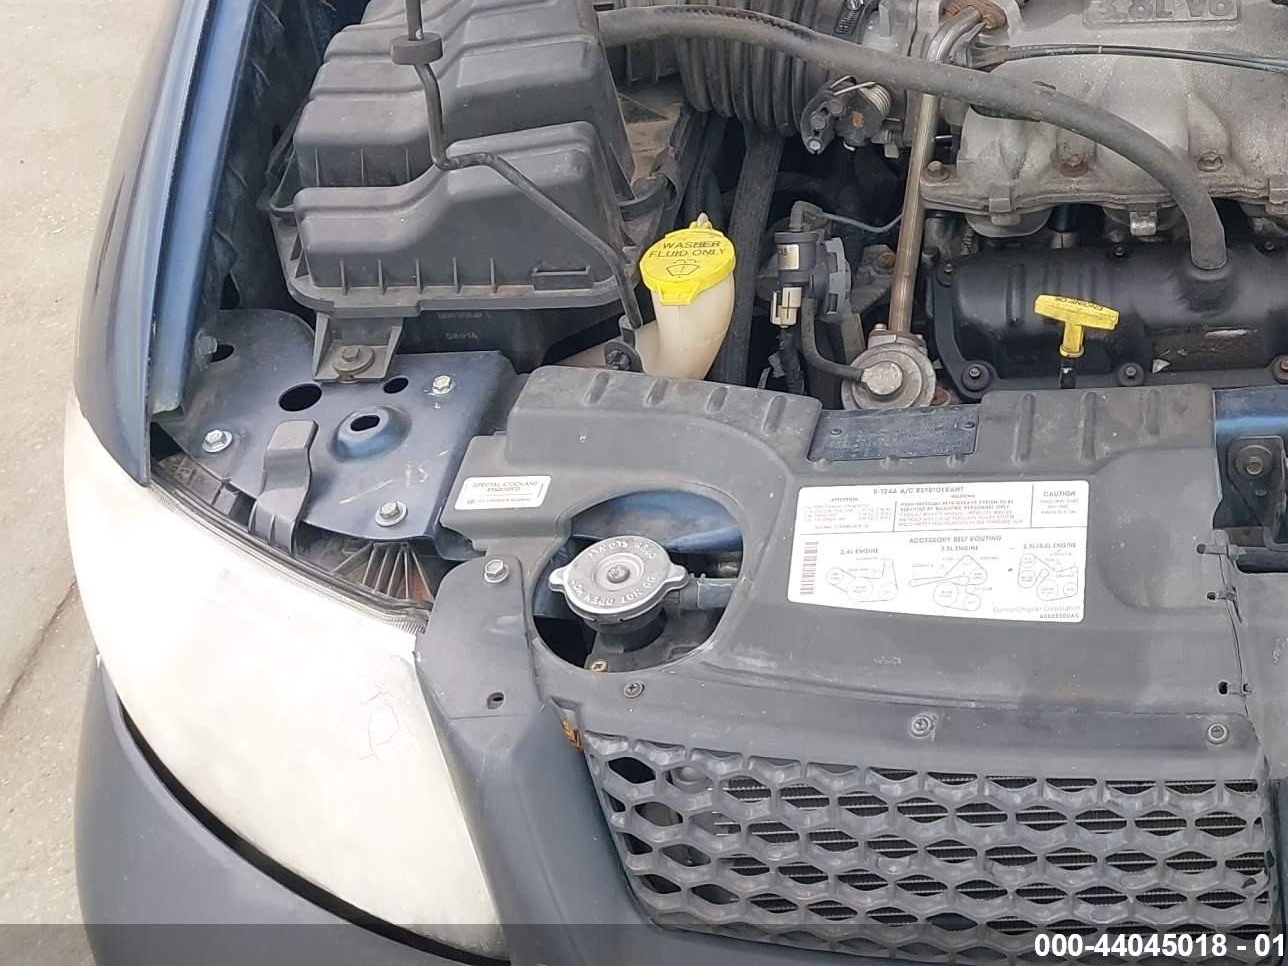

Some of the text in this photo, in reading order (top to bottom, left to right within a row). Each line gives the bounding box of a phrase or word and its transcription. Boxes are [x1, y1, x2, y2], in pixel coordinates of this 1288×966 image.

[663, 240, 721, 249] WASHER
[648, 248, 725, 258] FLUID ONLY
[900, 487, 914, 495] A/C
[916, 486, 964, 494] REFRIGERANT
[1043, 490, 1076, 498] CAUTION
